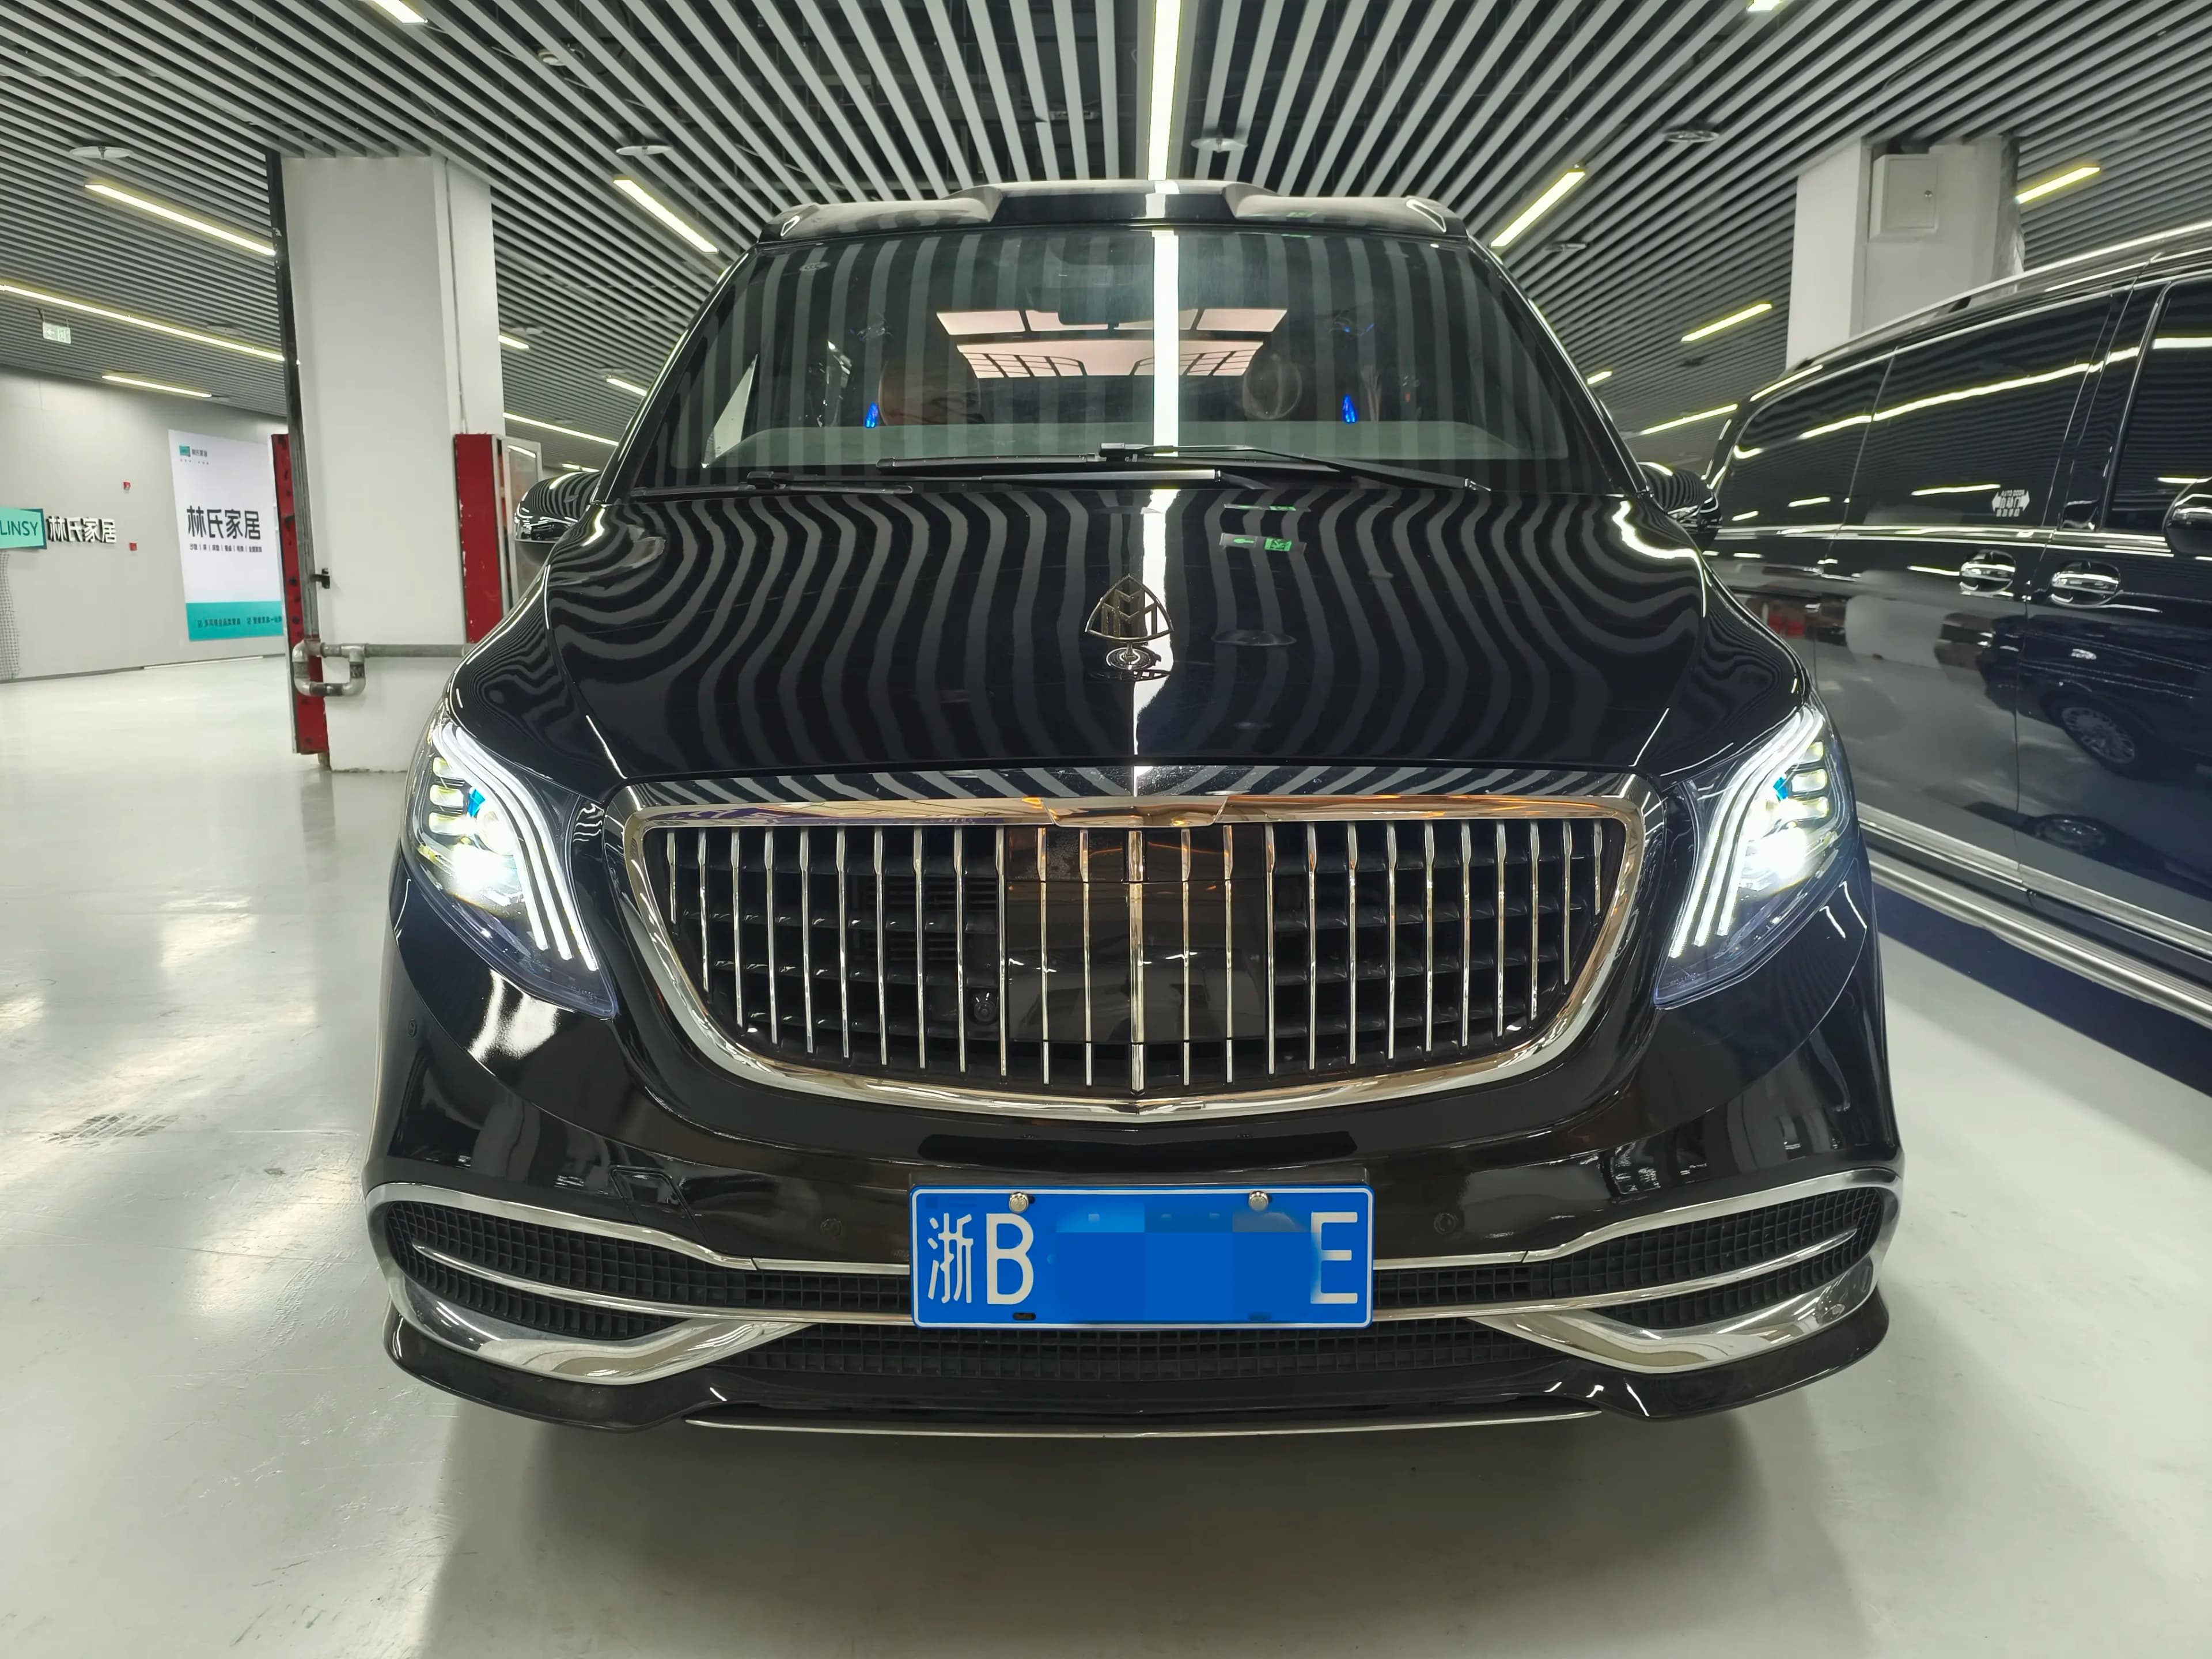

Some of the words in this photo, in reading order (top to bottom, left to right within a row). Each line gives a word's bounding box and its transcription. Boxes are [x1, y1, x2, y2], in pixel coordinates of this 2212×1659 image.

[0, 520, 38, 536] LINSY
[47, 516, 117, 543] 林氏家居
[187, 505, 261, 540] 林氏家居
